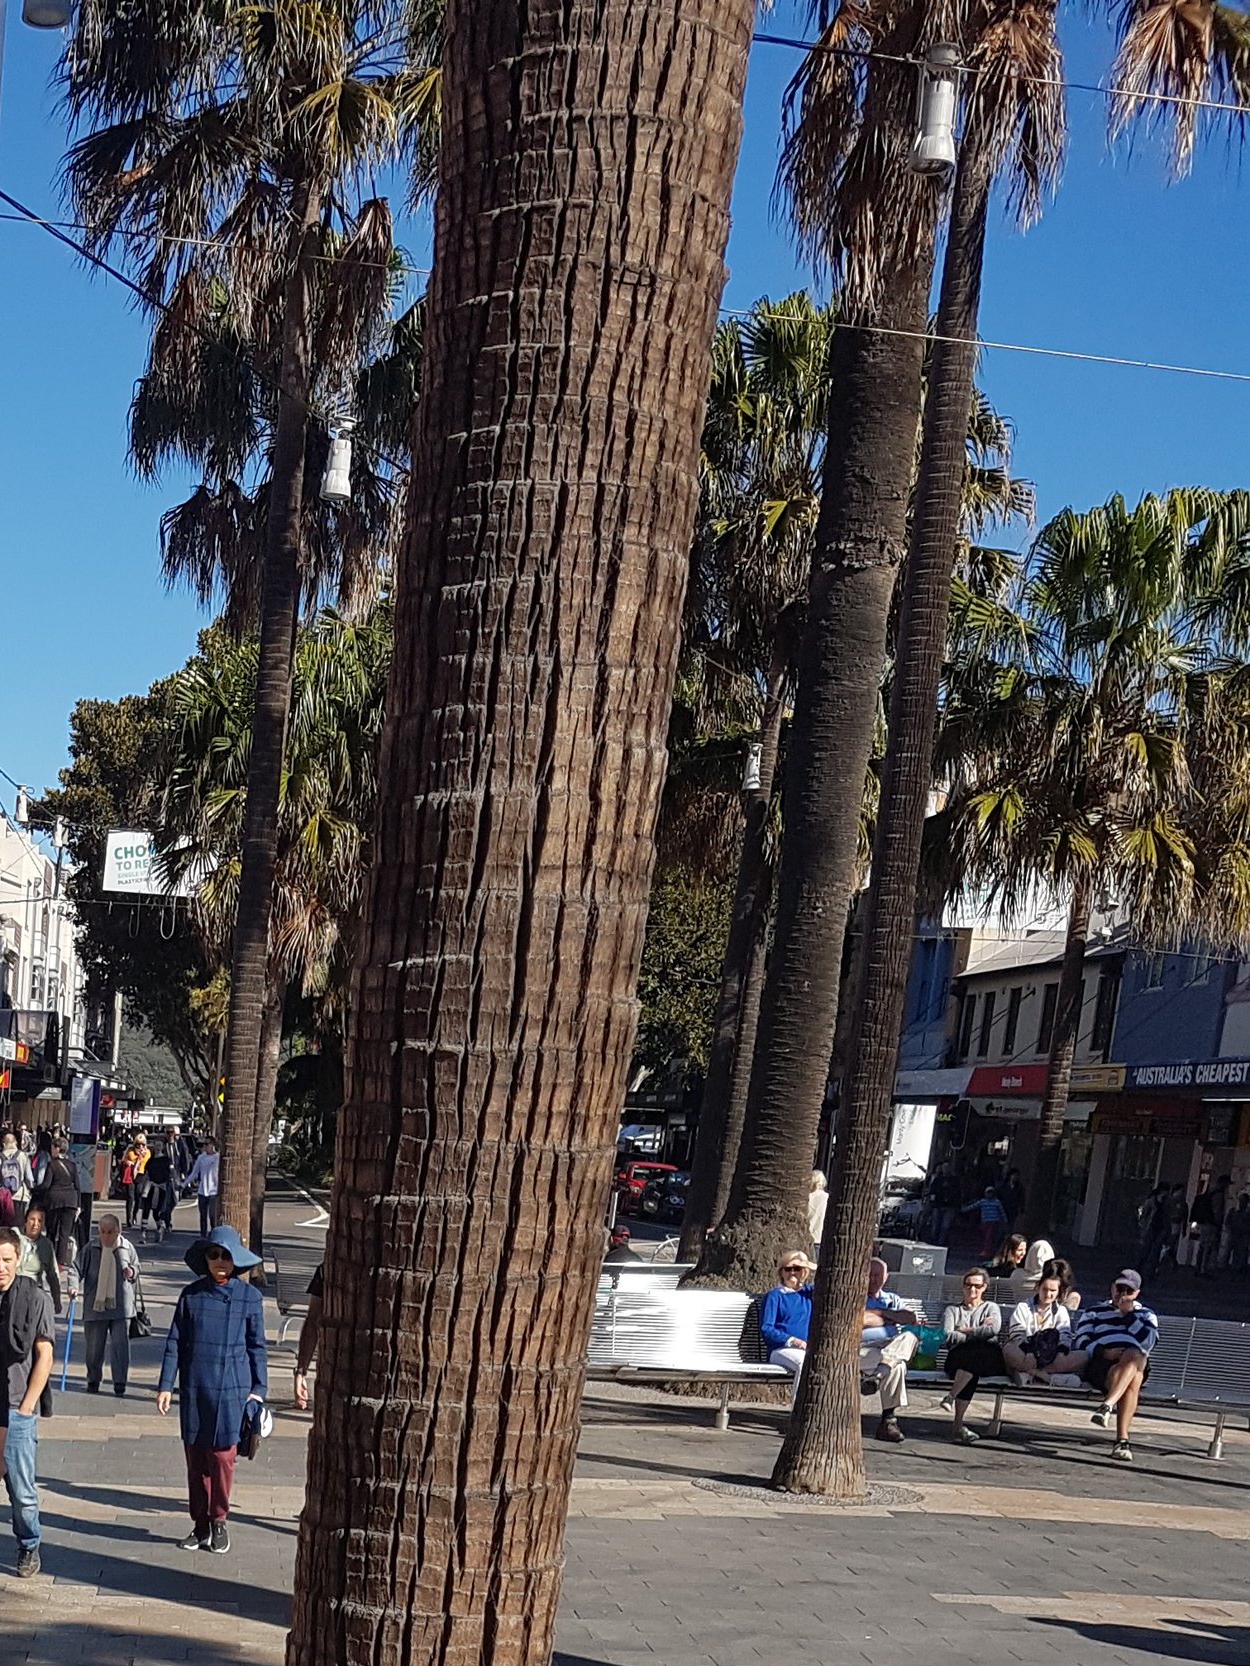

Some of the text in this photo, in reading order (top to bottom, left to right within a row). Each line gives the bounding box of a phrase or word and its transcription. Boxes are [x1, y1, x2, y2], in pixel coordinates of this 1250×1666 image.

[114, 844, 153, 860] CHO
[116, 861, 132, 871] TO
[1136, 1065, 1193, 1085] AUSTRALIA'S
[1195, 1062, 1250, 1083] CHEAPEST
